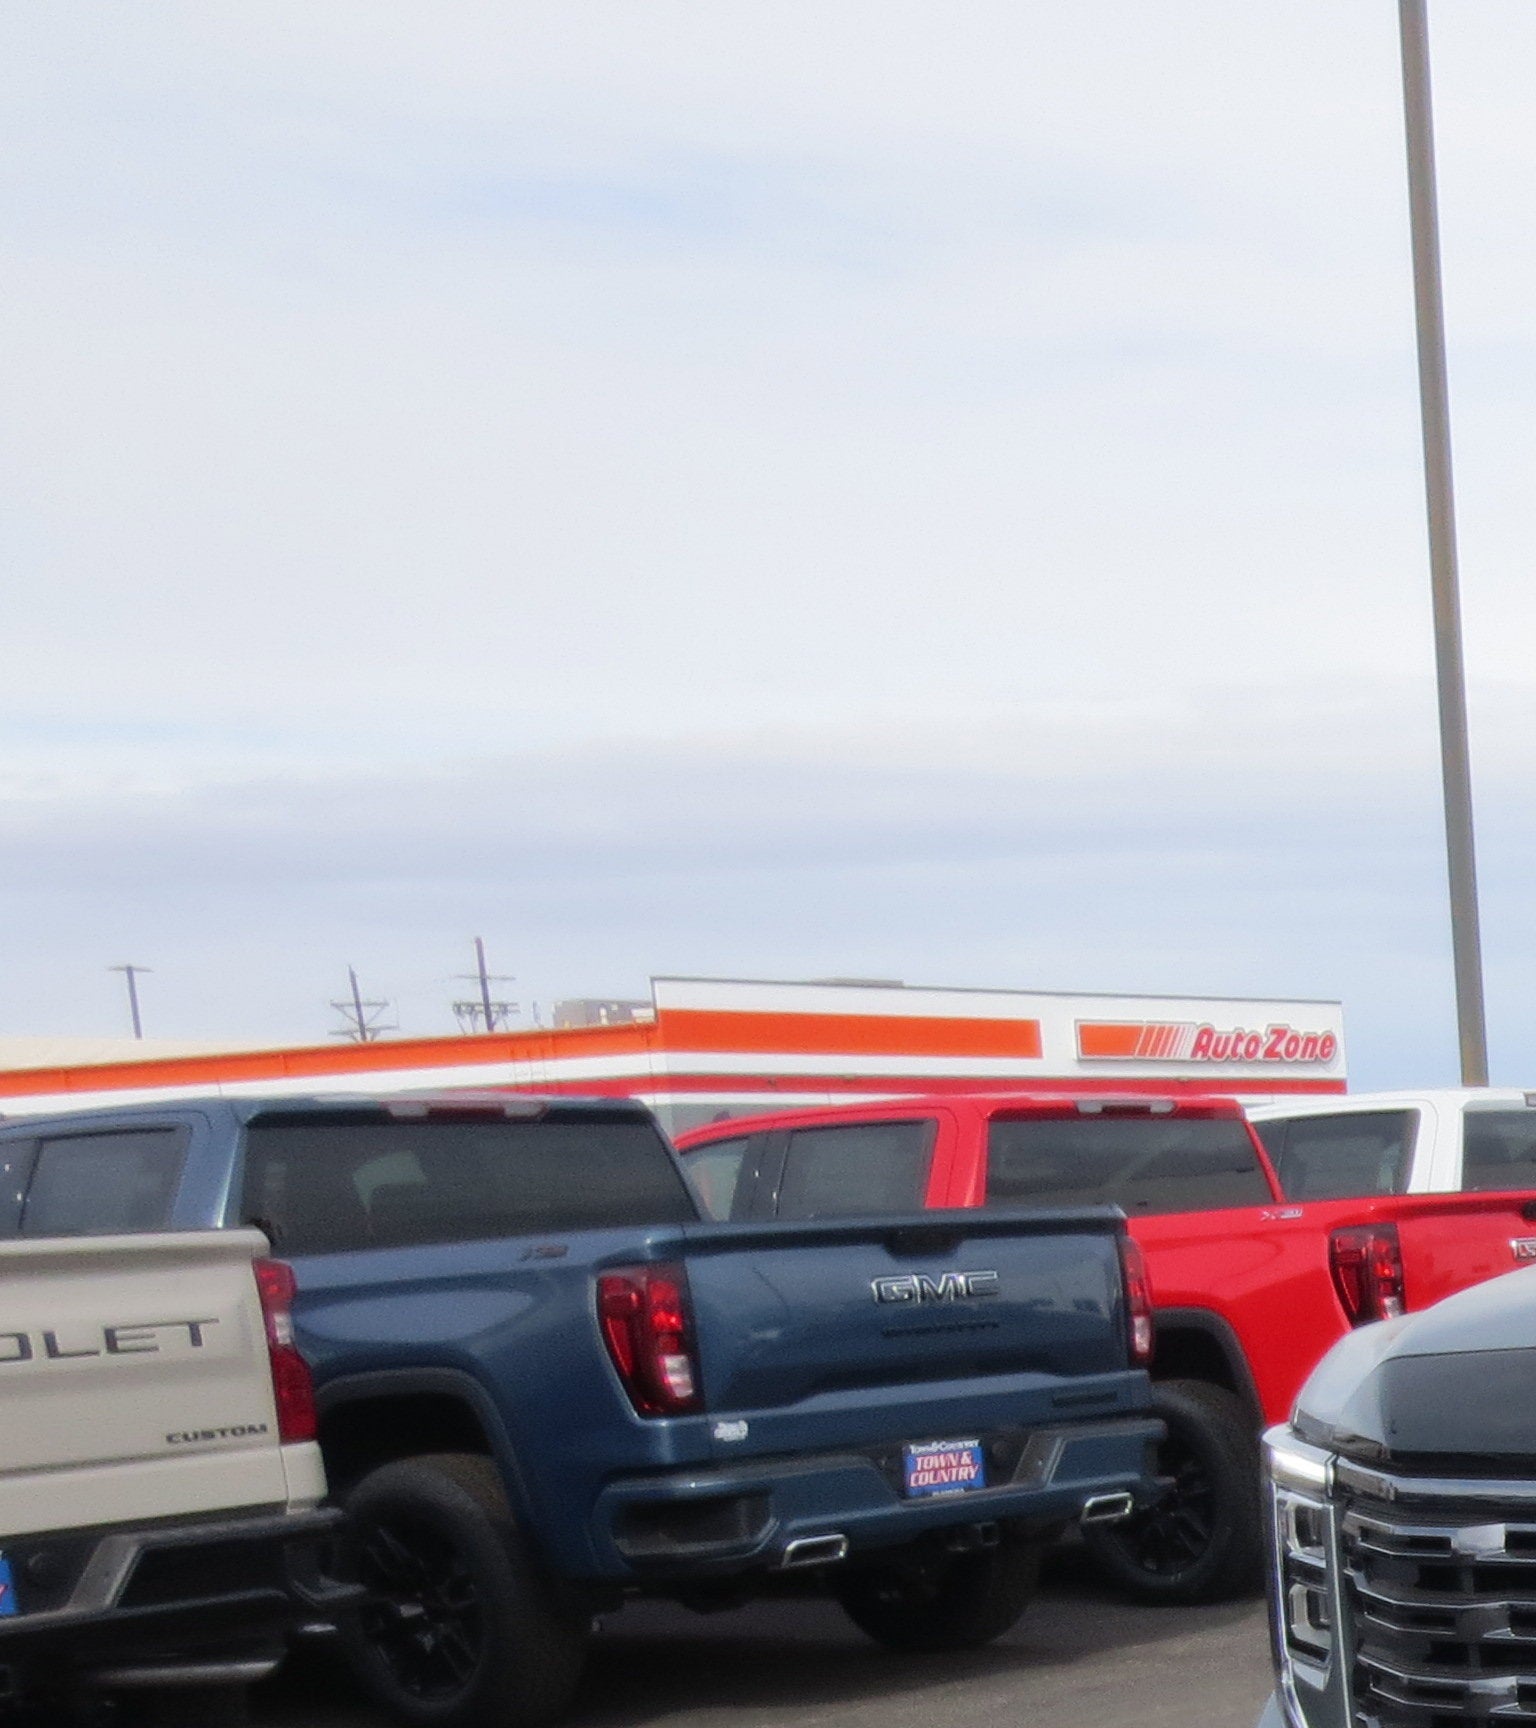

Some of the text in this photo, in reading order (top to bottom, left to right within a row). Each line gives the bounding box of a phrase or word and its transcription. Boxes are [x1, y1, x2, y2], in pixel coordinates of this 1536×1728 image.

[1190, 1024, 1336, 1060] AutoZone
[870, 1269, 998, 1304] GMC
[166, 1423, 268, 1445] CUSTOM
[915, 1450, 973, 1471] TOWN &
[909, 1463, 979, 1488] COUNTRY
